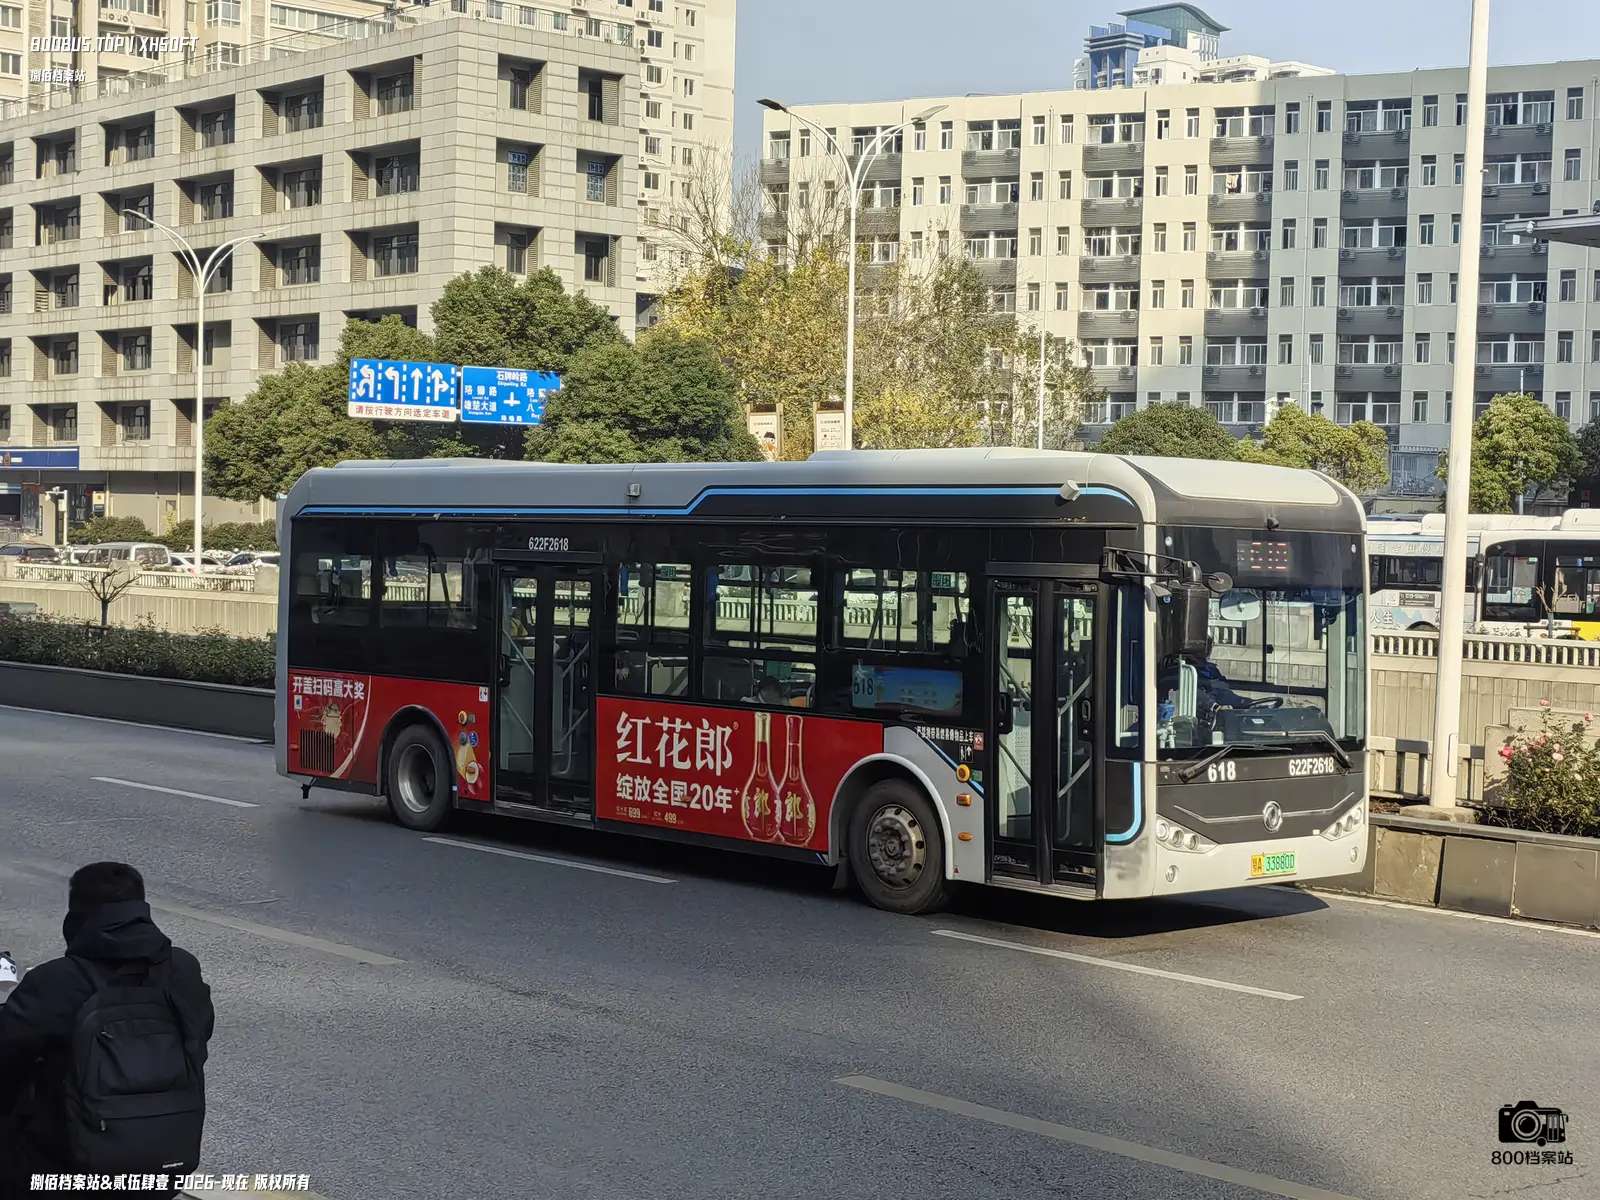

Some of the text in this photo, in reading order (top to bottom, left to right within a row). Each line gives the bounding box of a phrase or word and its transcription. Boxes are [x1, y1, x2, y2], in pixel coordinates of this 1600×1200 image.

[355, 405, 450, 419] 请按行驶方向选定车道
[529, 536, 569, 551] 622F2618
[1207, 760, 1236, 782] 618
[1288, 757, 1335, 776] 622F2618
